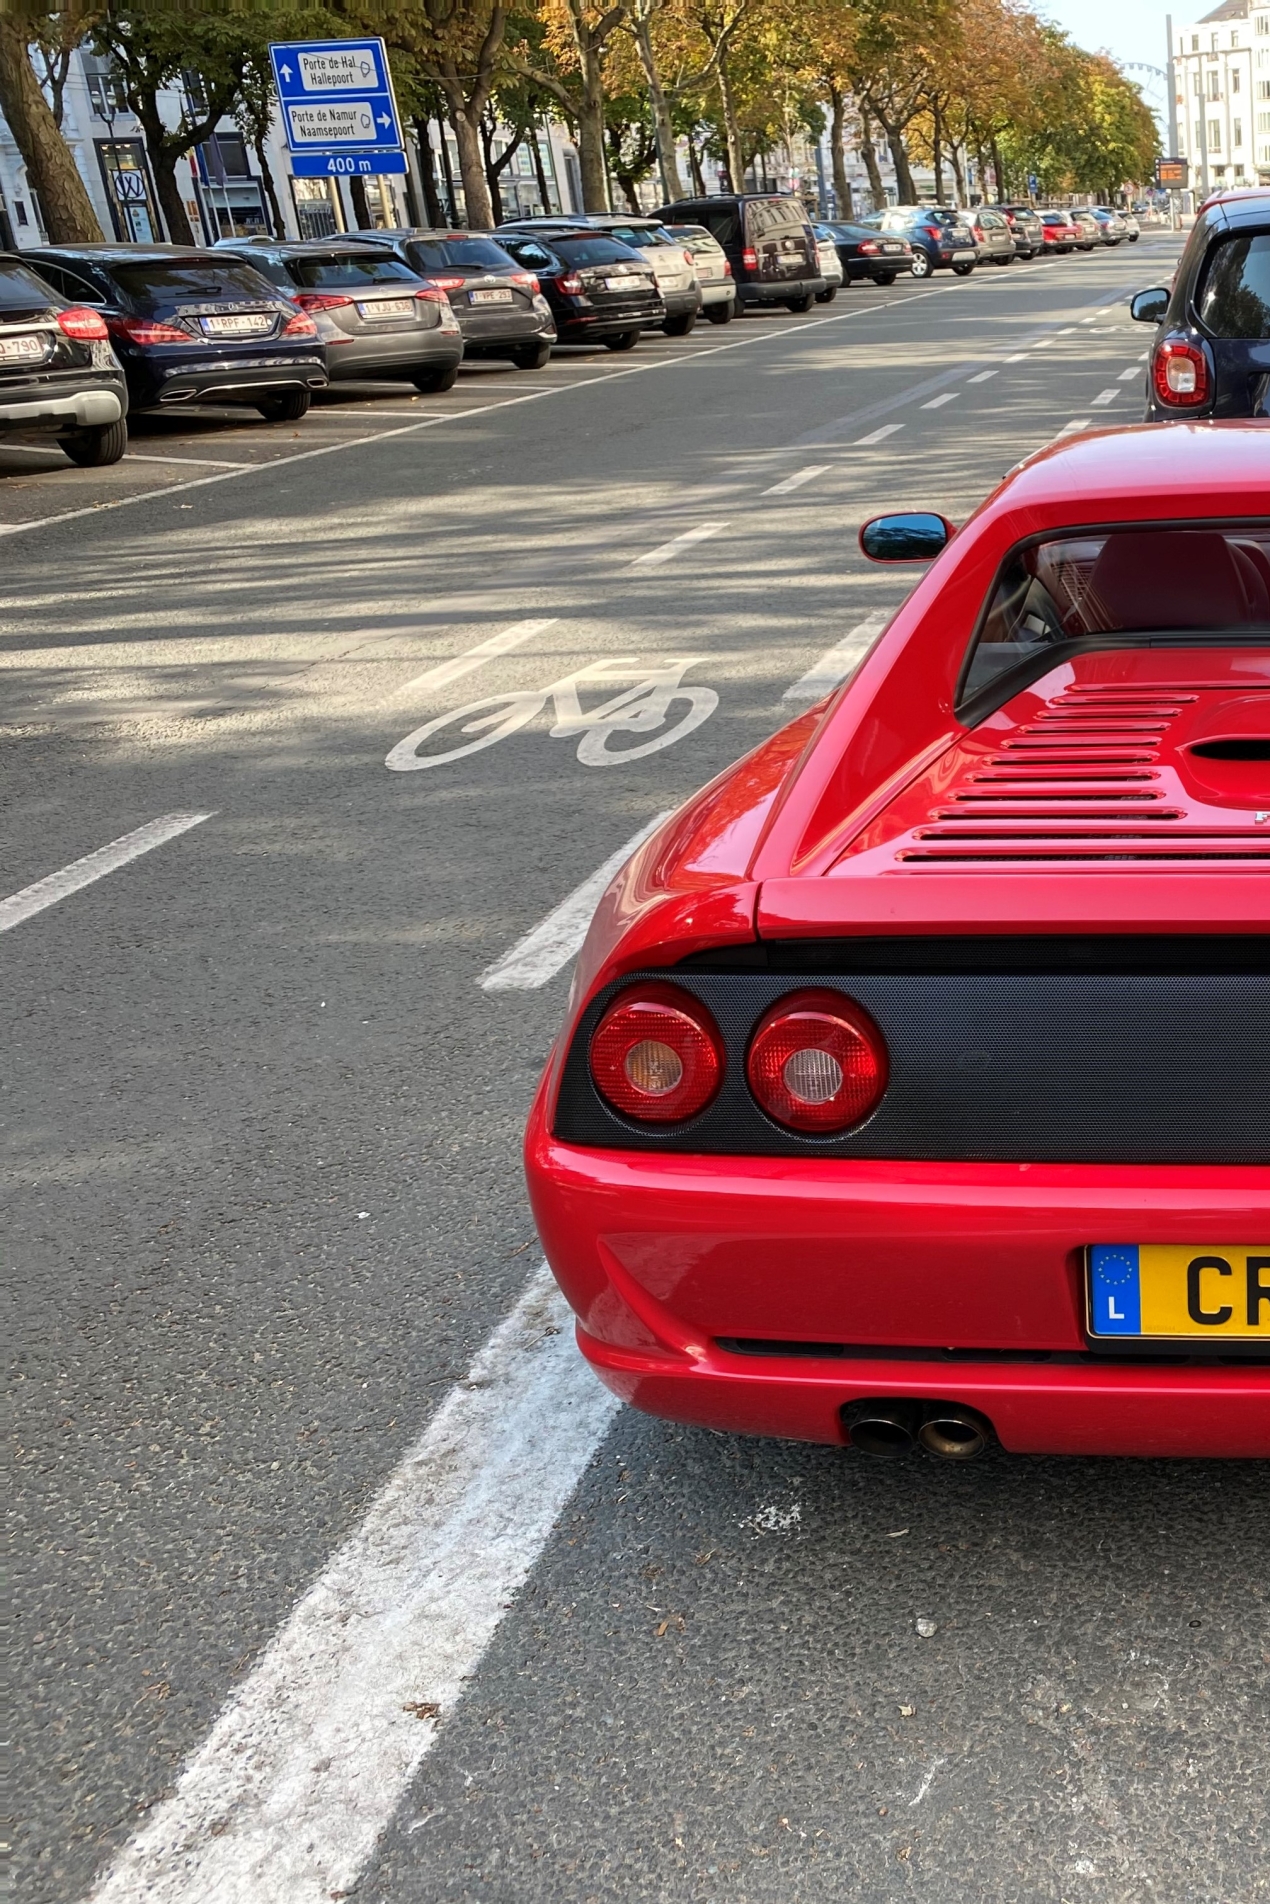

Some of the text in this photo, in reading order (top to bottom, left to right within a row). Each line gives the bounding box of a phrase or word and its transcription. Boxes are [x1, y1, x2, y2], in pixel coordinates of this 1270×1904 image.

[303, 56, 356, 71] Porte de Hal
[310, 72, 354, 87] Hallepoort
[291, 109, 357, 123] Porte de Namur
[300, 124, 355, 138] Naamsepoort
[327, 157, 372, 173] 400 m
[1108, 1296, 1125, 1319] L
